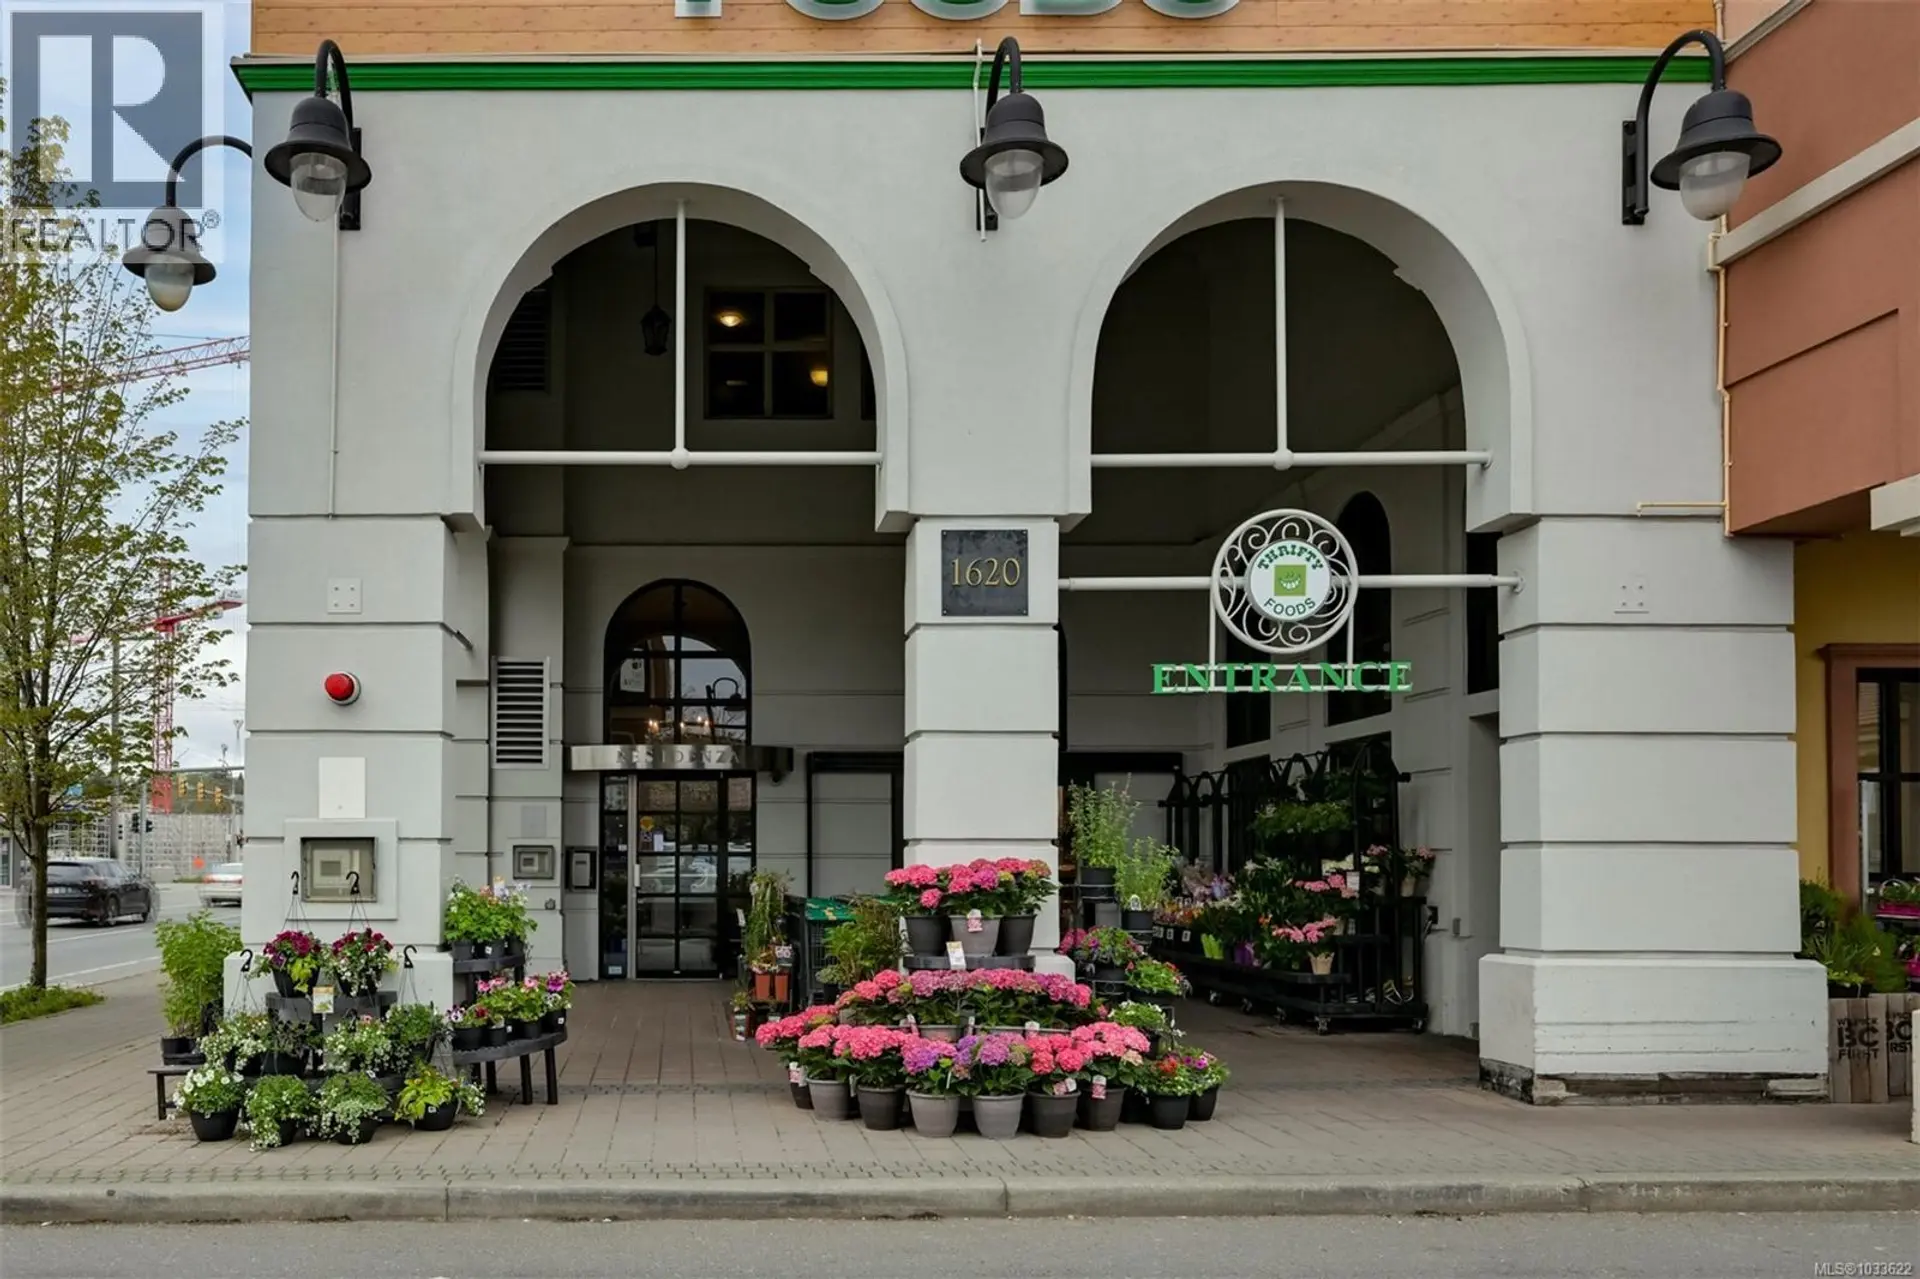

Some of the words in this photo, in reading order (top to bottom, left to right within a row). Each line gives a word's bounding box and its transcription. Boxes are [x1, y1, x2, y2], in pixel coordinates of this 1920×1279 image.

[1257, 544, 1324, 571] THRIFTY
[951, 557, 1021, 587] 1620
[1263, 597, 1316, 617] FOODS
[1150, 660, 1414, 694] ENTRANCE
[616, 749, 740, 764] RESIDENZA
[1837, 1025, 1879, 1048] BC
